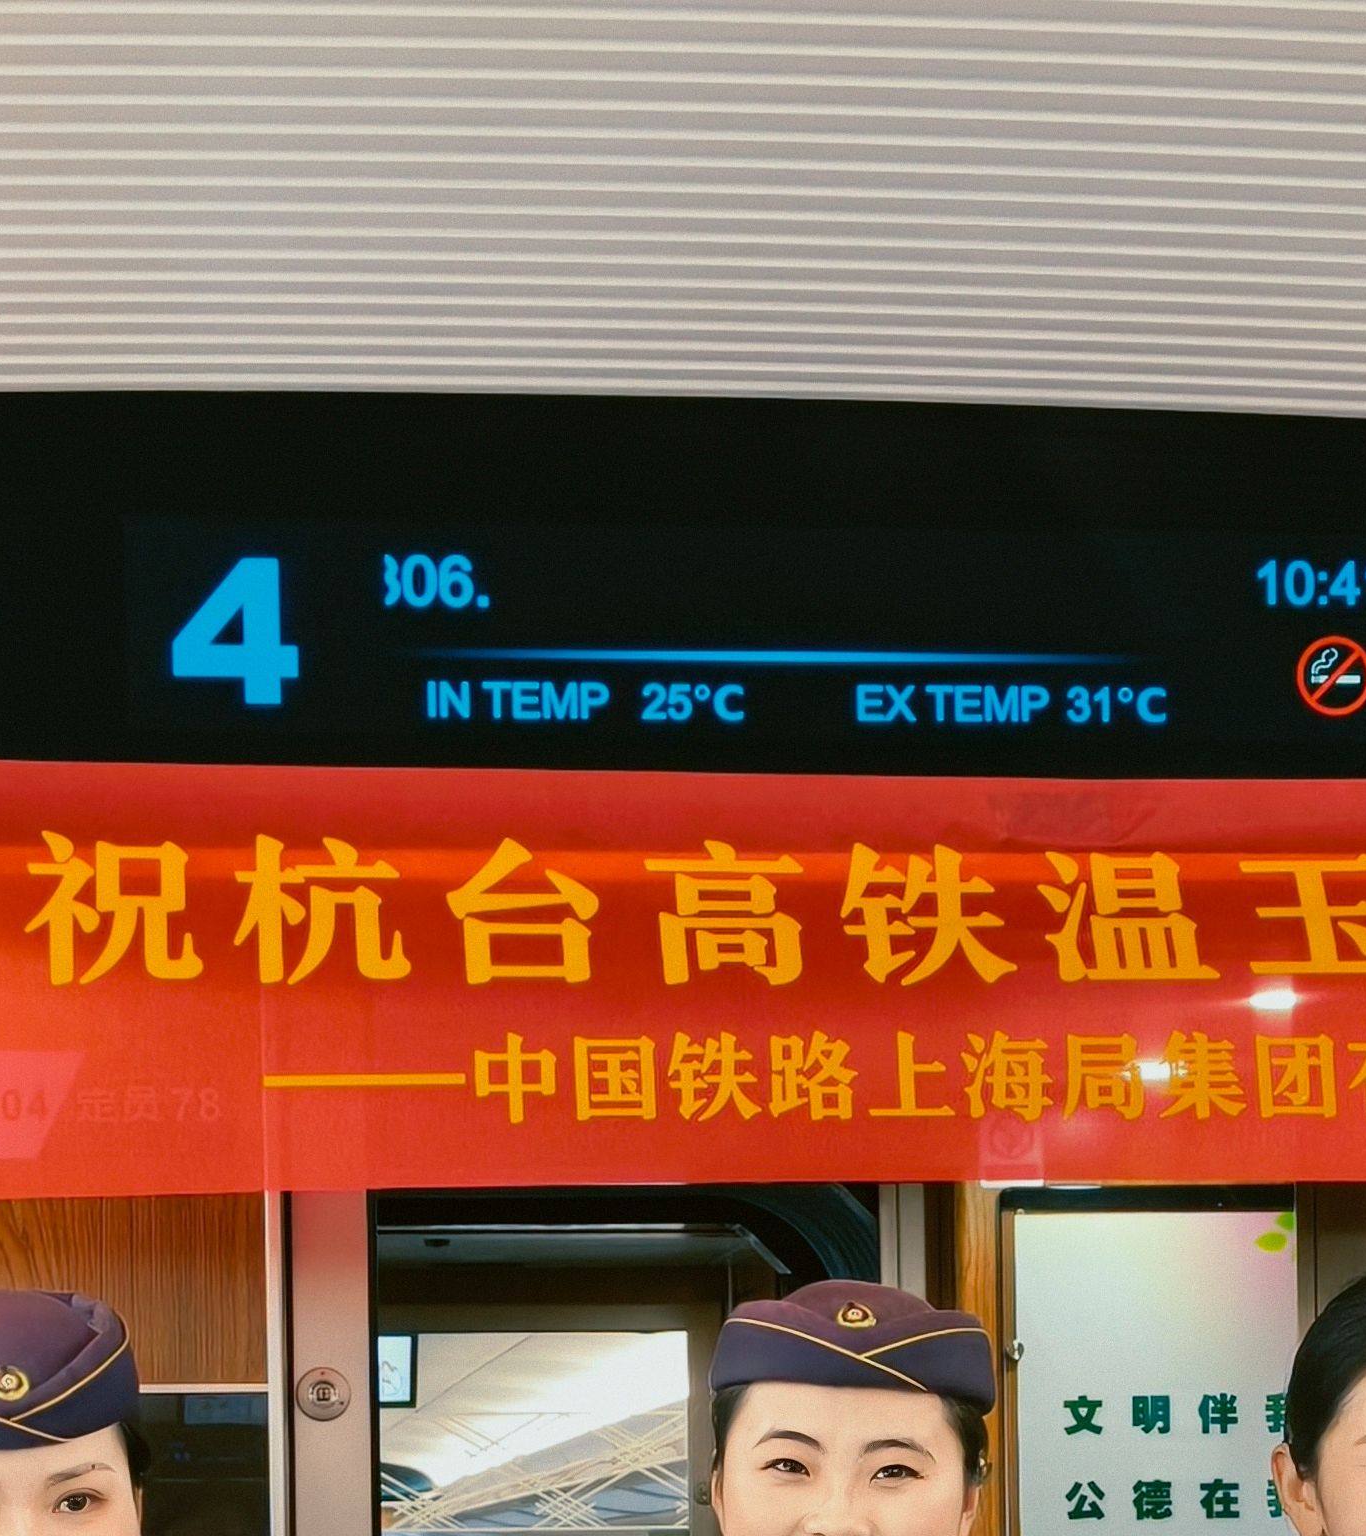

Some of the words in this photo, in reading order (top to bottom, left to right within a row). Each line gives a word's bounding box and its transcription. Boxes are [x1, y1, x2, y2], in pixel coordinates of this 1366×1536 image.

[172, 557, 299, 704] 4
[427, 681, 470, 718] IN
[482, 681, 609, 720] TEMP
[642, 683, 744, 722] 25°C
[856, 684, 917, 723] EX
[926, 684, 1049, 723] TEMP
[1067, 686, 1166, 723] 31°C
